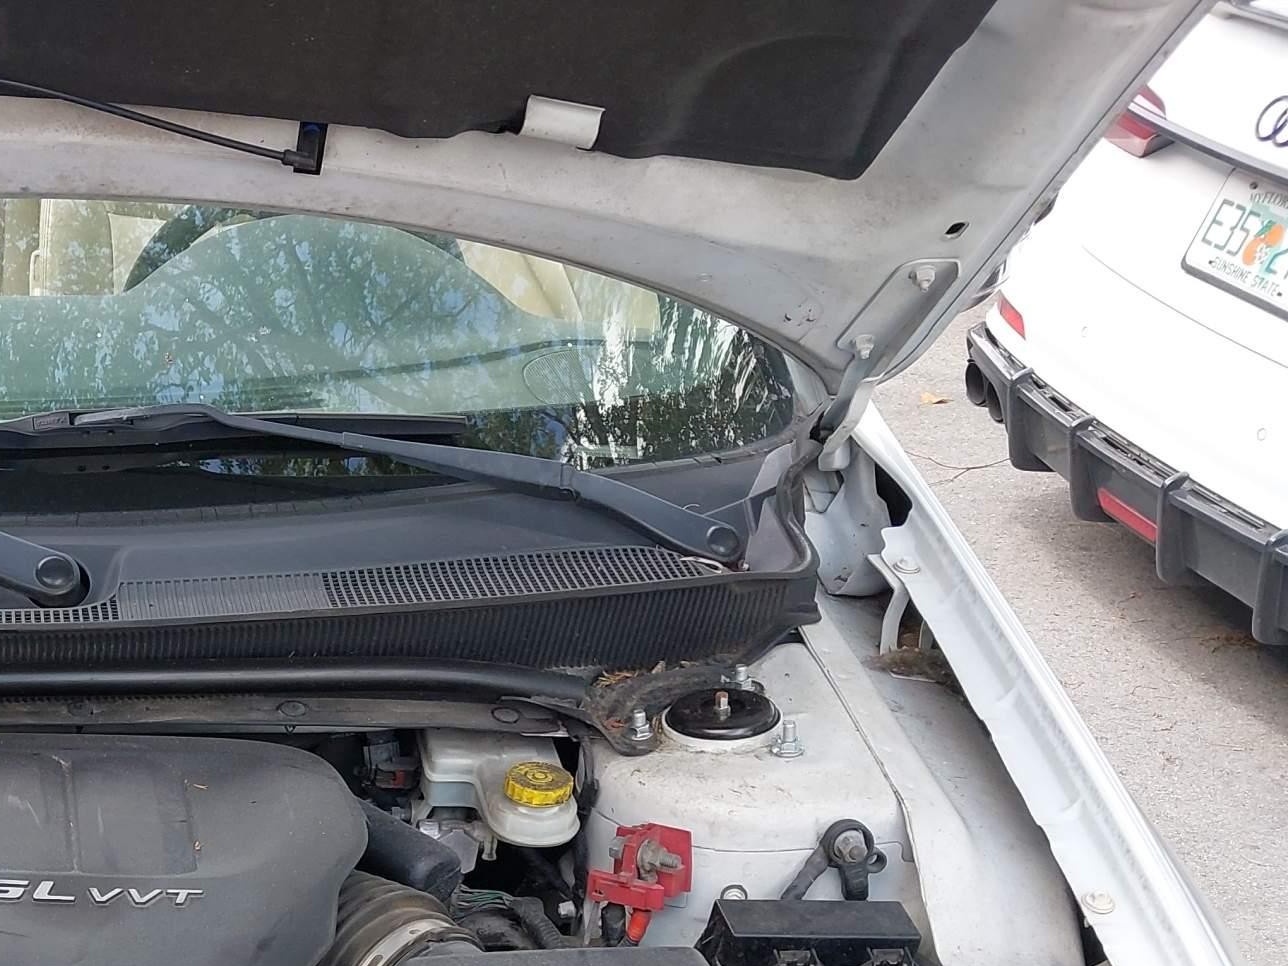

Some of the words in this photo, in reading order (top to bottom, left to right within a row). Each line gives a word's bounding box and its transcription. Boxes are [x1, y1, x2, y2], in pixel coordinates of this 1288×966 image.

[1202, 198, 1262, 257] E35
[1211, 256, 1252, 284] SUNSHINE
[1250, 273, 1281, 297] STATE
[88, 887, 205, 907] VVT
